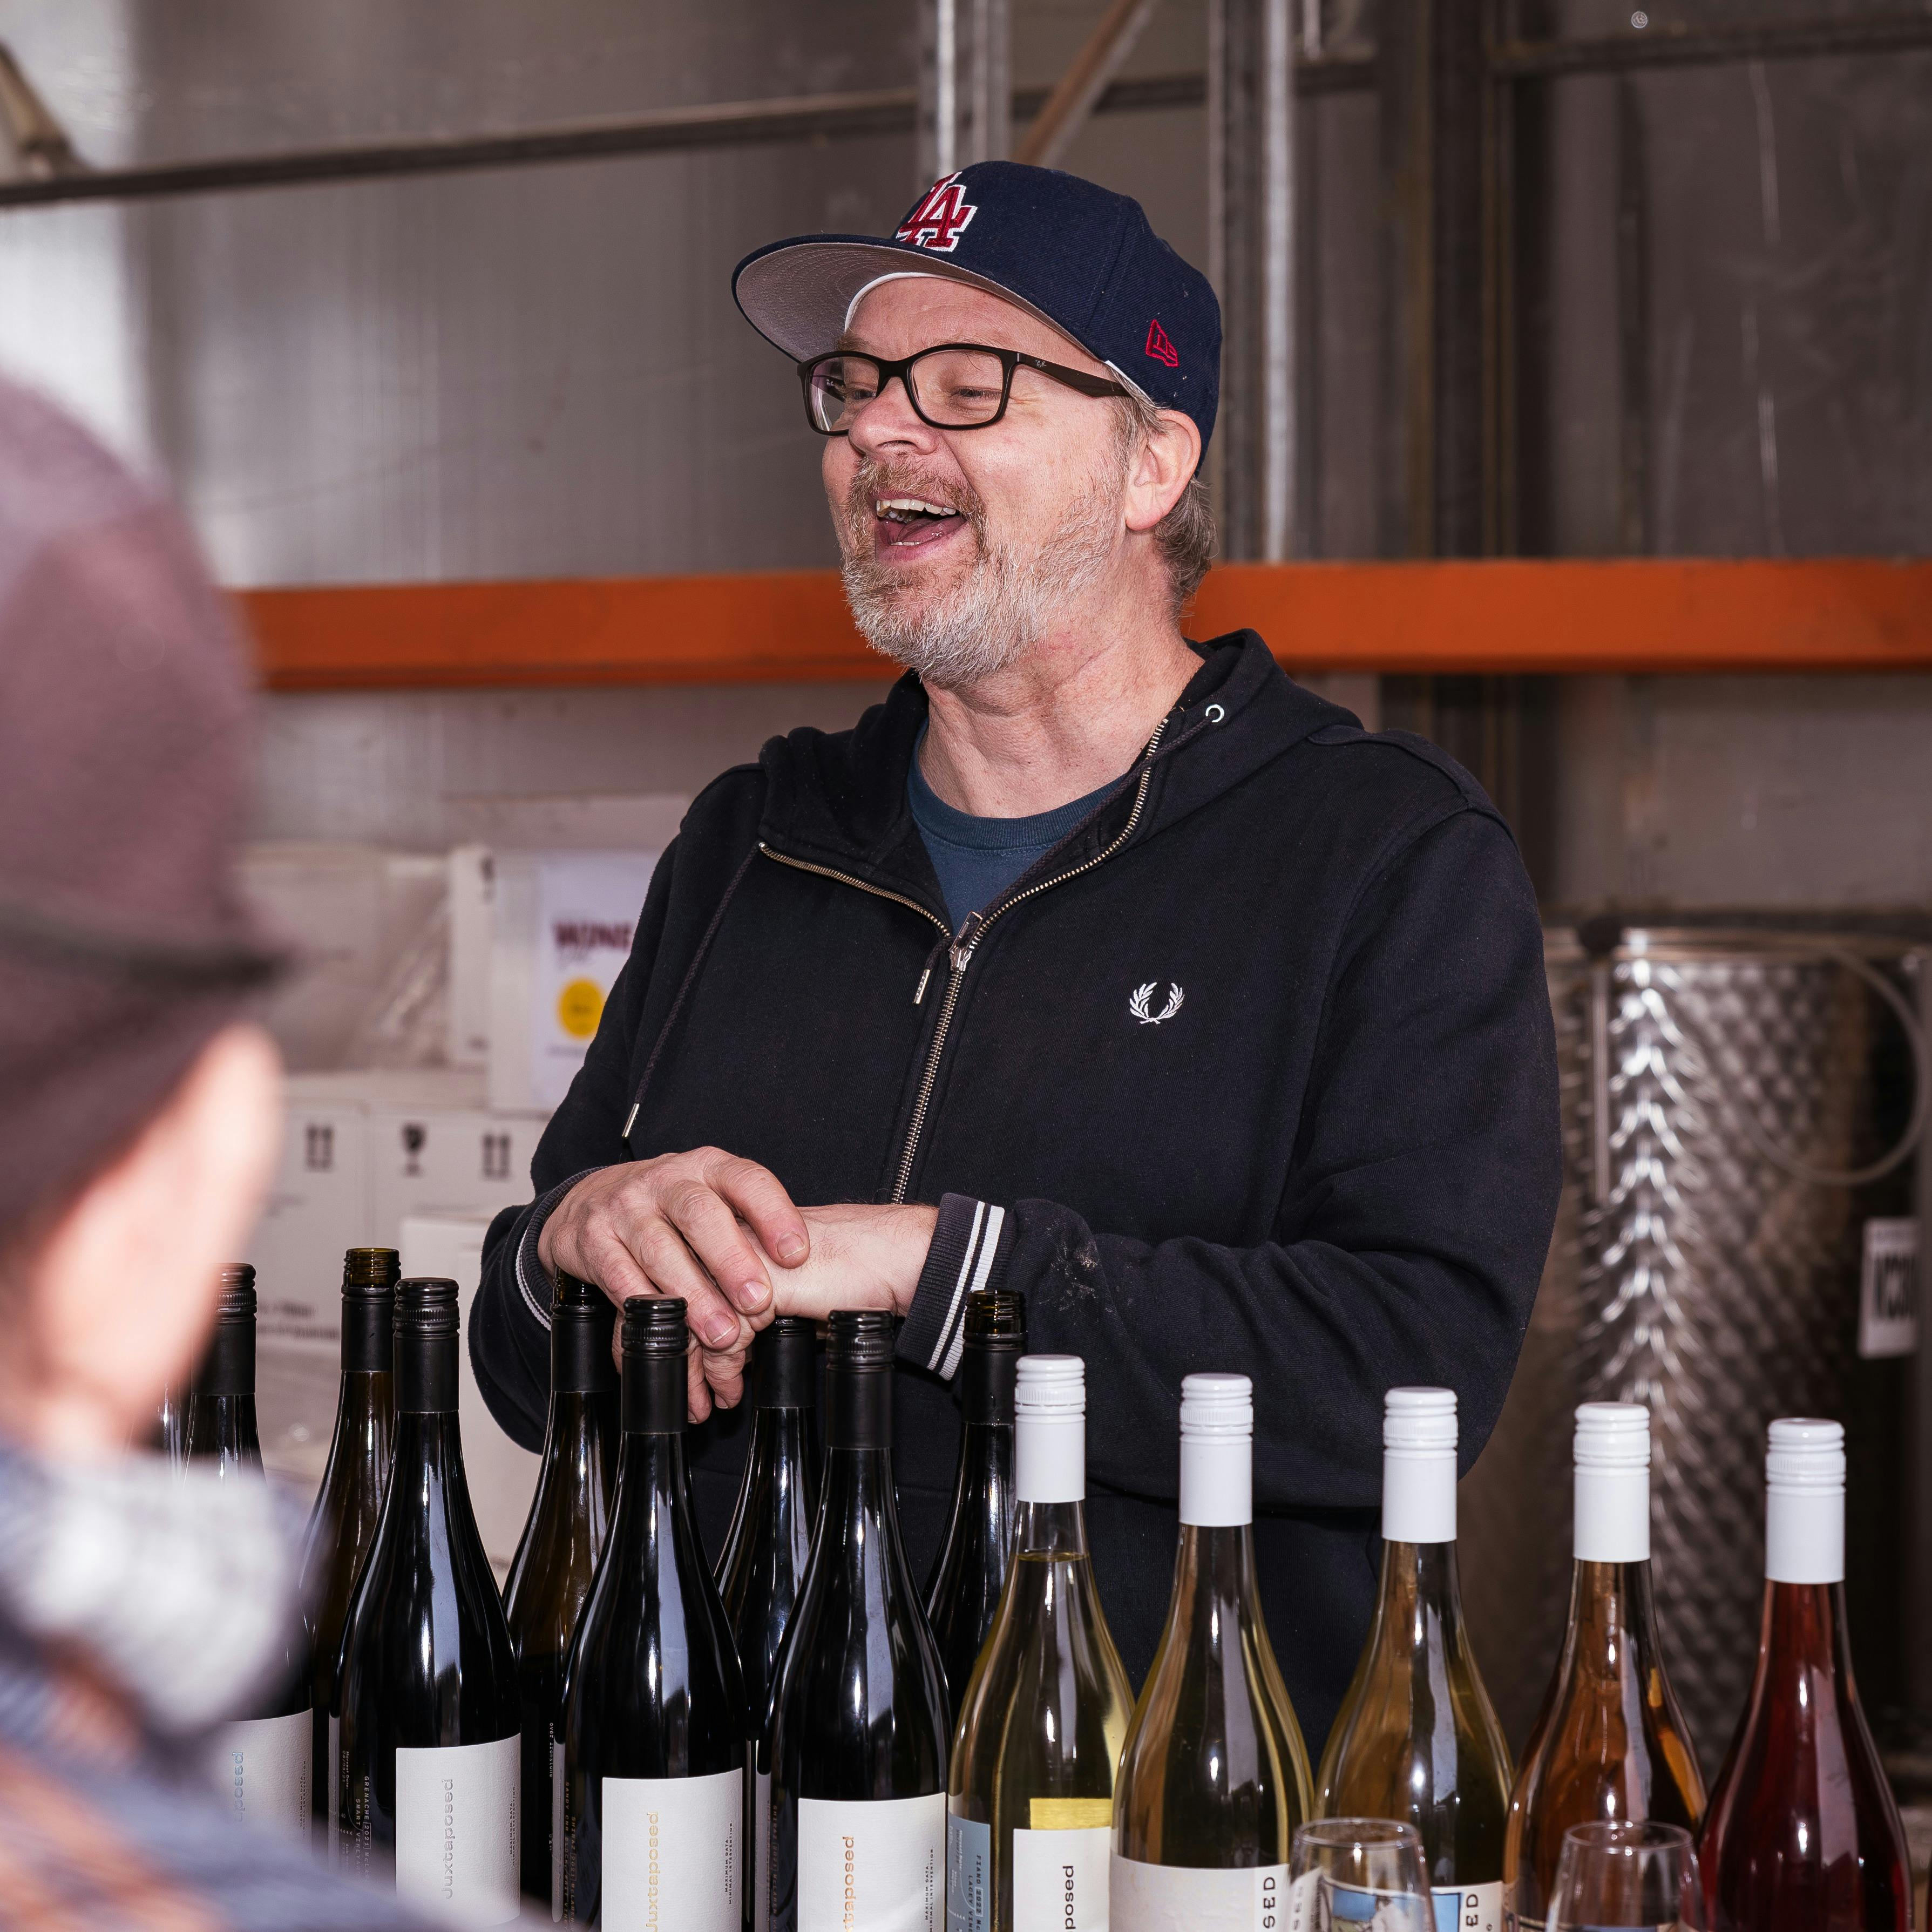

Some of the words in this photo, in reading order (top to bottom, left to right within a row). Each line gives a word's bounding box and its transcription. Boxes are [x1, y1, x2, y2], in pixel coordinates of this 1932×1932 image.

[896, 171, 978, 252] LA
[1062, 1865, 1076, 1930] posed
[1263, 1877, 1275, 1929] SED
[1466, 1894, 1479, 1927] ED
